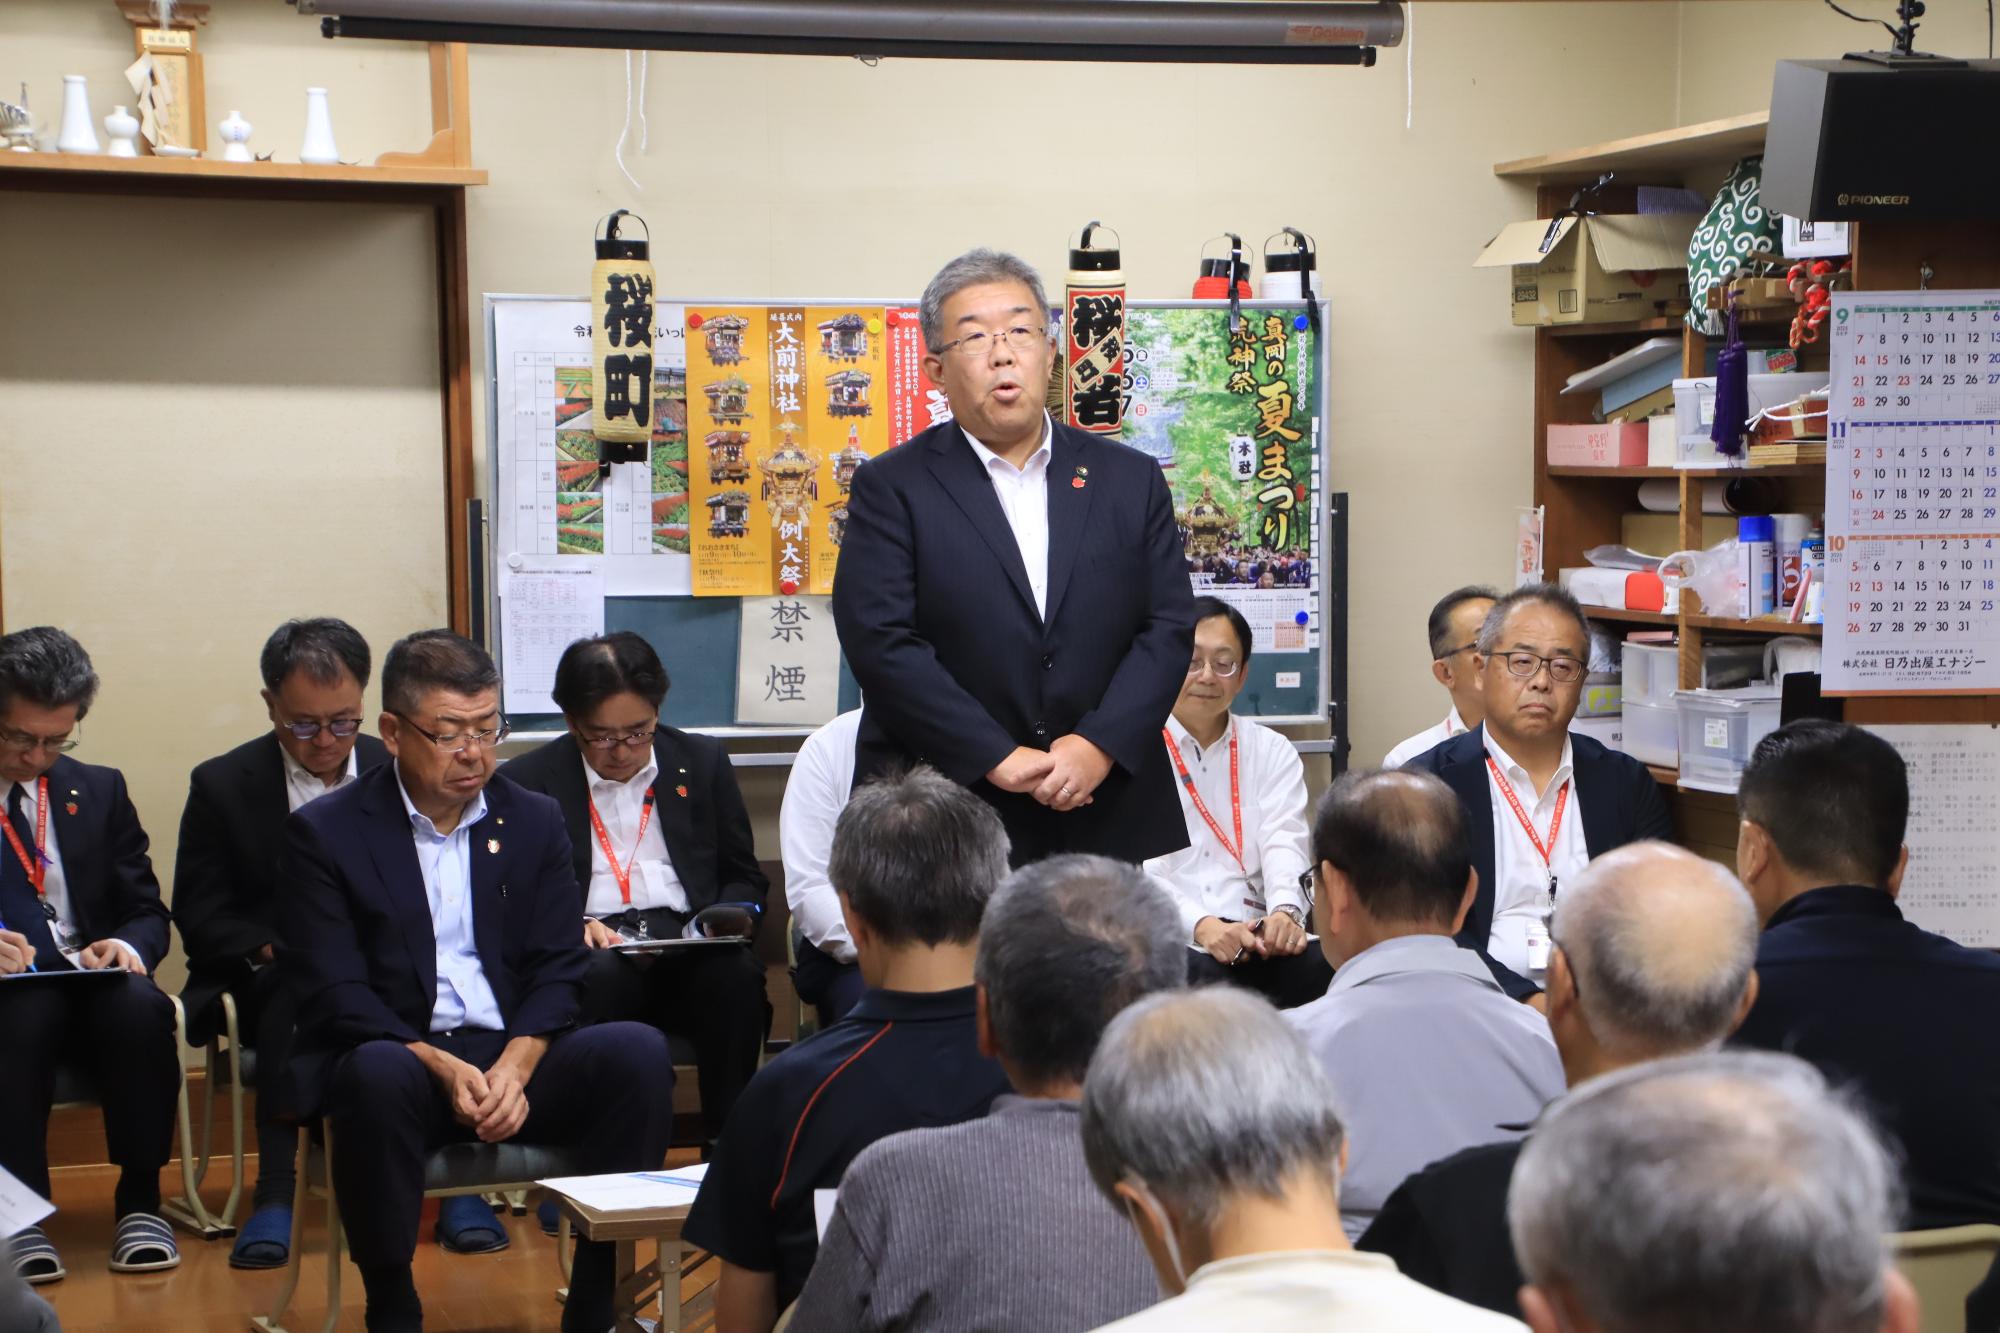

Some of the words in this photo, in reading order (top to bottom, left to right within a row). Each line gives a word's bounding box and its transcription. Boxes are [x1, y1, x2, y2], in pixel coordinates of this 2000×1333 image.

[1851, 195, 1910, 206] PIONEER
[1836, 308, 1849, 324] 9
[1881, 313, 1886, 323] 1
[1903, 313, 1910, 323] 2
[1926, 312, 1932, 322] 3
[1948, 312, 1955, 322] 4
[1971, 312, 1977, 322] 5
[1994, 312, 2000, 322] 6
[1858, 335, 1864, 344] 7
[1880, 335, 1885, 344] 8
[1902, 334, 1908, 343] 9
[1923, 334, 1934, 343] 10
[1946, 333, 1954, 342] 11
[1968, 333, 1979, 342] 12
[1992, 333, 2000, 342] 13
[604, 272, 653, 428] 桜町
[1227, 317, 1257, 394] 荒神祭
[1855, 356, 1865, 365] 14
[1878, 355, 1888, 365] 15
[1900, 355, 1910, 364] 16
[1923, 355, 1933, 364] 17
[1945, 354, 1955, 364] 18
[1968, 354, 1978, 363] 19
[1989, 353, 2000, 363] 20
[775, 321, 801, 415] 大前神社
[1853, 376, 1863, 386] 21
[1876, 376, 1887, 385] 22
[1898, 376, 1910, 385] 23
[1920, 376, 1932, 385] 24
[1943, 375, 1955, 384] 25
[1966, 375, 1977, 384] 26
[1988, 374, 2000, 384] 27
[1853, 397, 1864, 406] 28
[1876, 397, 1887, 406] 29
[1898, 396, 1910, 406] 30
[1255, 315, 1302, 551] 真岡の夏まつり
[1831, 422, 1845, 437] 11
[1989, 426, 1994, 436] 1
[1237, 441, 1253, 475] 本社
[1855, 449, 1860, 458] 2
[1877, 448, 1882, 458] 3
[1899, 448, 1904, 457] 4
[1922, 448, 1927, 457] 5
[1944, 448, 1949, 457] 6
[1967, 447, 1972, 456] 7
[1989, 447, 1994, 456] 8
[1854, 469, 1860, 479] 9
[1875, 469, 1885, 478] 10
[1897, 469, 1906, 478] 11
[1920, 468, 1929, 478] 12
[1942, 468, 1952, 477] 13
[1964, 467, 1974, 477] 14
[1986, 467, 1996, 477] 15
[1853, 490, 1862, 499] 16
[1874, 490, 1884, 499] 17
[1897, 489, 1907, 498] 18
[1919, 489, 1929, 498] 19
[1940, 489, 1951, 498] 20
[1962, 488, 1972, 498] 21
[1984, 488, 1996, 497] 22
[1873, 510, 1884, 520] 24
[1895, 510, 1906, 519] 25
[1917, 510, 1928, 519] 26
[1939, 509, 1951, 519] 27
[1962, 509, 1973, 518] 28
[1984, 508, 1995, 518] 29
[1828, 536, 1845, 551] 10
[1919, 540, 1924, 549] 1
[1942, 539, 1948, 549] 2
[1964, 539, 1970, 549] 3
[1986, 539, 1992, 549] 4
[778, 519, 804, 586] 例大祭
[1852, 562, 1858, 571] 5
[1874, 562, 1880, 571] 6
[1897, 561, 1902, 570] 7
[1919, 561, 1924, 570] 8
[1941, 560, 1946, 570] 9
[1962, 560, 1972, 569] 10
[1984, 560, 1992, 569] 11
[1850, 582, 1860, 591] 12
[1872, 582, 1882, 591] 13
[1895, 582, 1904, 591] 14
[1917, 581, 1927, 591] 15
[1939, 581, 1949, 590] 16
[1961, 581, 1971, 590] 17
[1983, 580, 1993, 590] 18
[1850, 602, 1860, 612] 19
[1871, 603, 1882, 612] 20
[1893, 602, 1903, 611] 21
[1915, 601, 1926, 611] 22
[1937, 601, 1948, 611] 23
[1959, 601, 1970, 610] 24
[1981, 601, 1993, 610] 25
[1848, 623, 1860, 632] 26
[1870, 623, 1882, 632] 27
[1892, 623, 1903, 632] 28
[1914, 622, 1926, 631] 29
[1937, 622, 1948, 631] 30
[1959, 621, 1969, 631] 31
[764, 600, 811, 702] 禁煙
[1842, 659, 1878, 669] 株式会社
[1885, 656, 1986, 669] 日乃出屋エナジー
